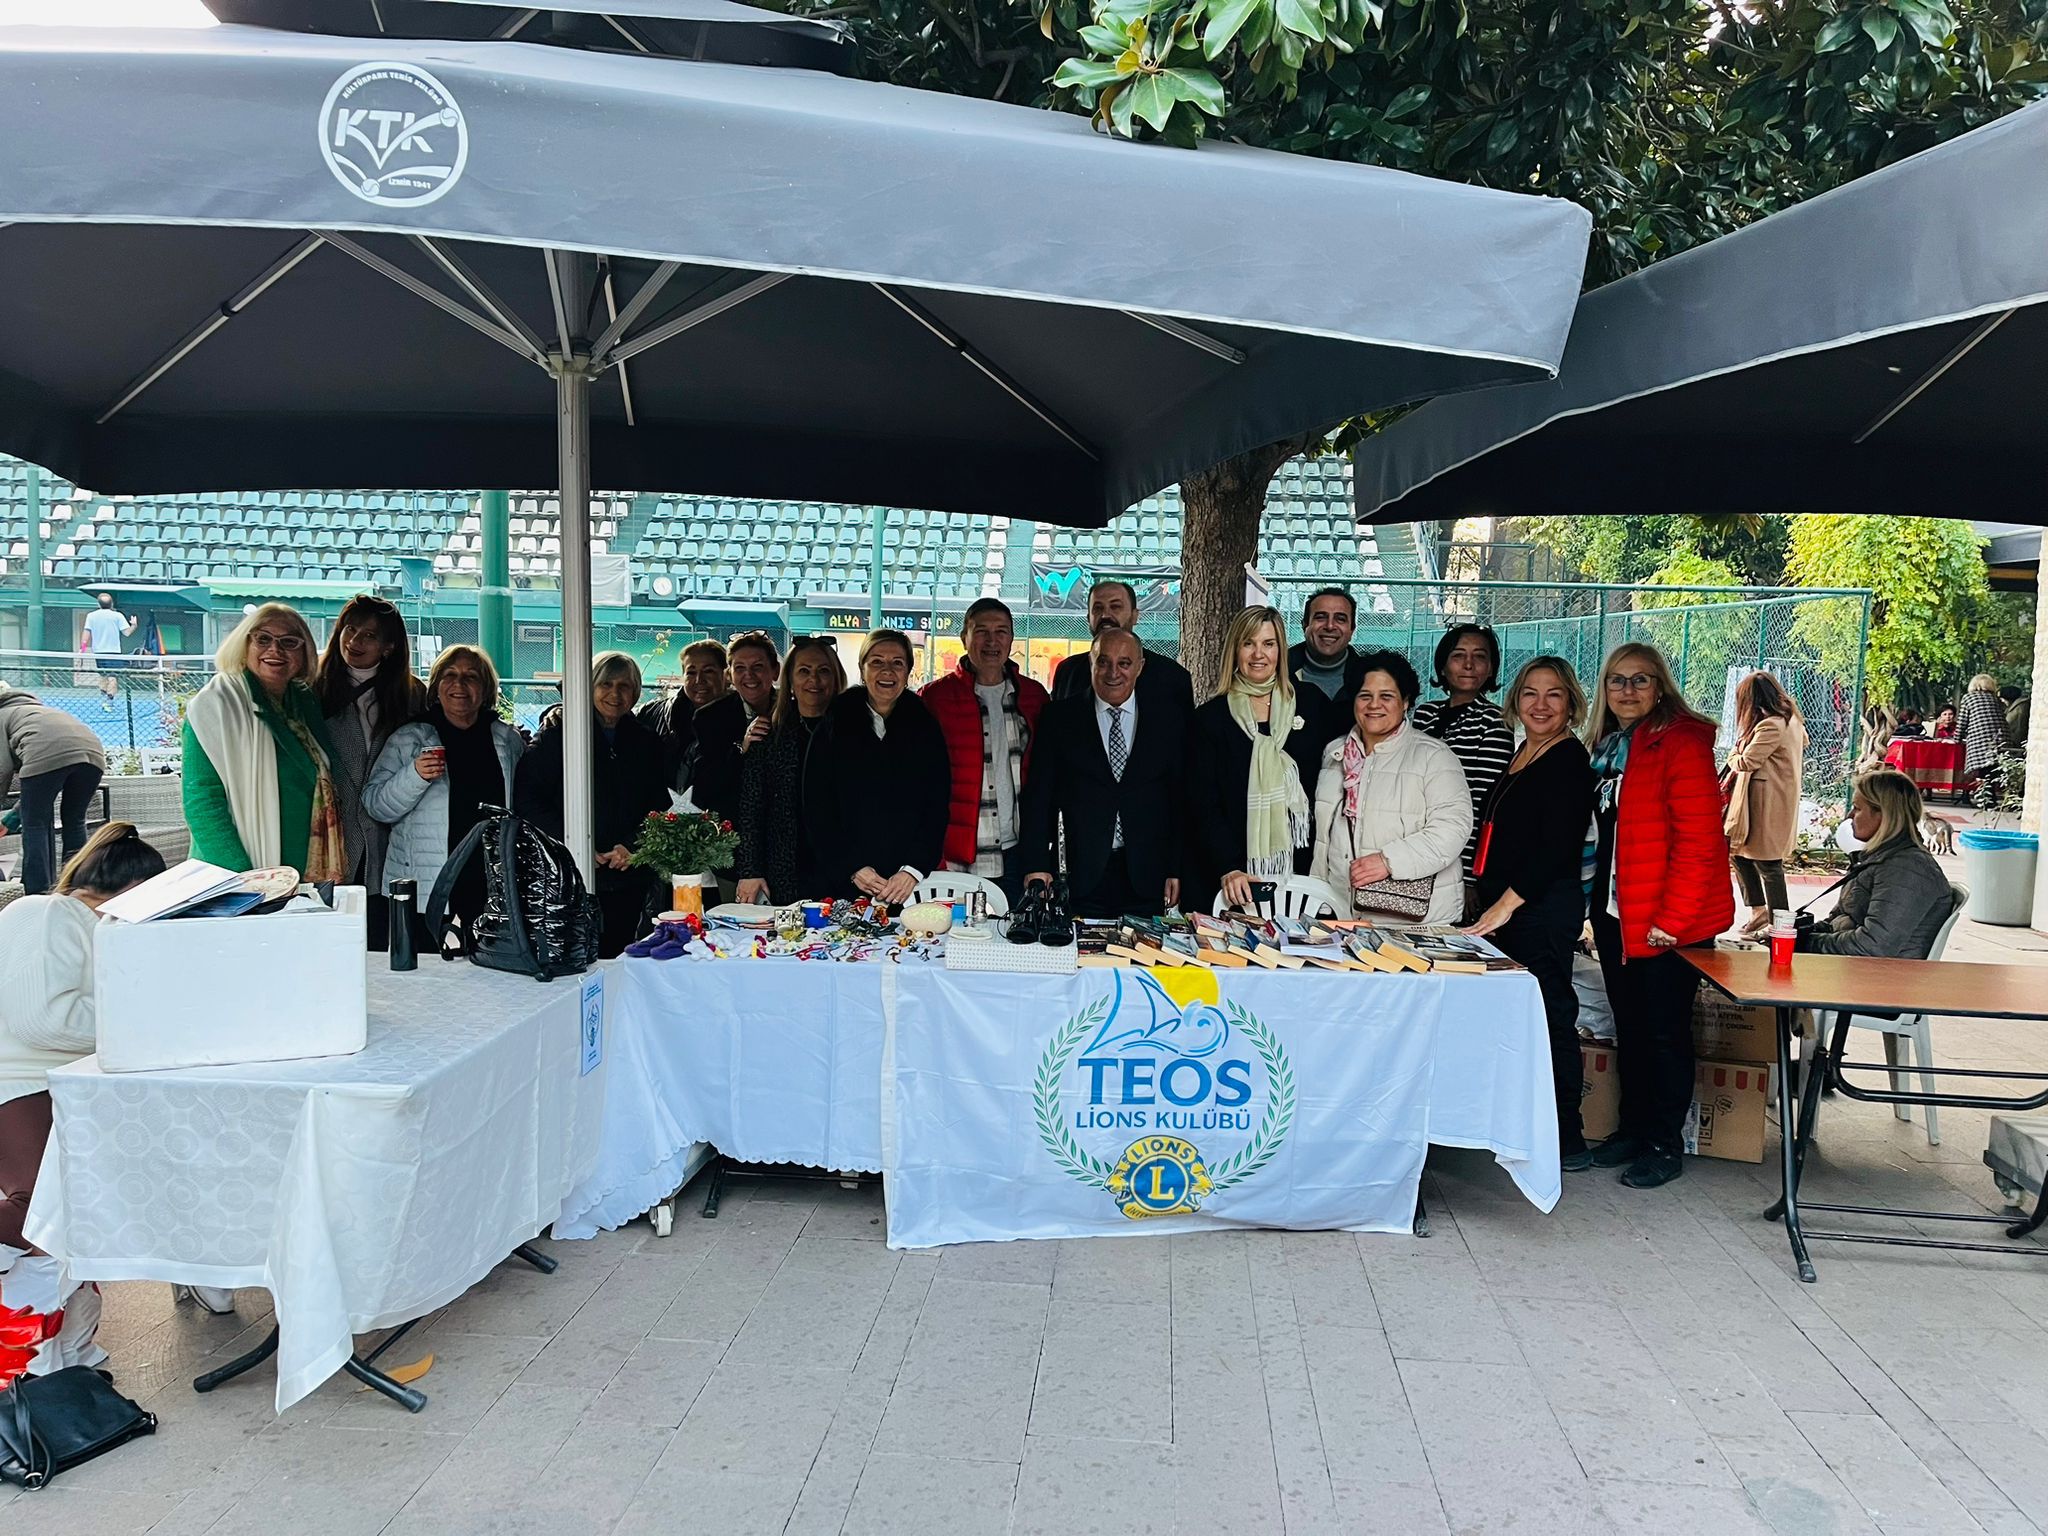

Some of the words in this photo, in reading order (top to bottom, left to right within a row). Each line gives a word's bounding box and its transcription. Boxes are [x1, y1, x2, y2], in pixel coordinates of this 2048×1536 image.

[334, 108, 436, 153] KTK
[829, 614, 860, 628] ALYA
[864, 615, 914, 629] TNNIS
[1077, 1057, 1252, 1108] TEOS
[1075, 1106, 1147, 1129] LİONS
[1155, 1108, 1251, 1130] KULÜBÜ
[1130, 1138, 1192, 1160] LIONS
[1147, 1165, 1175, 1200] L
